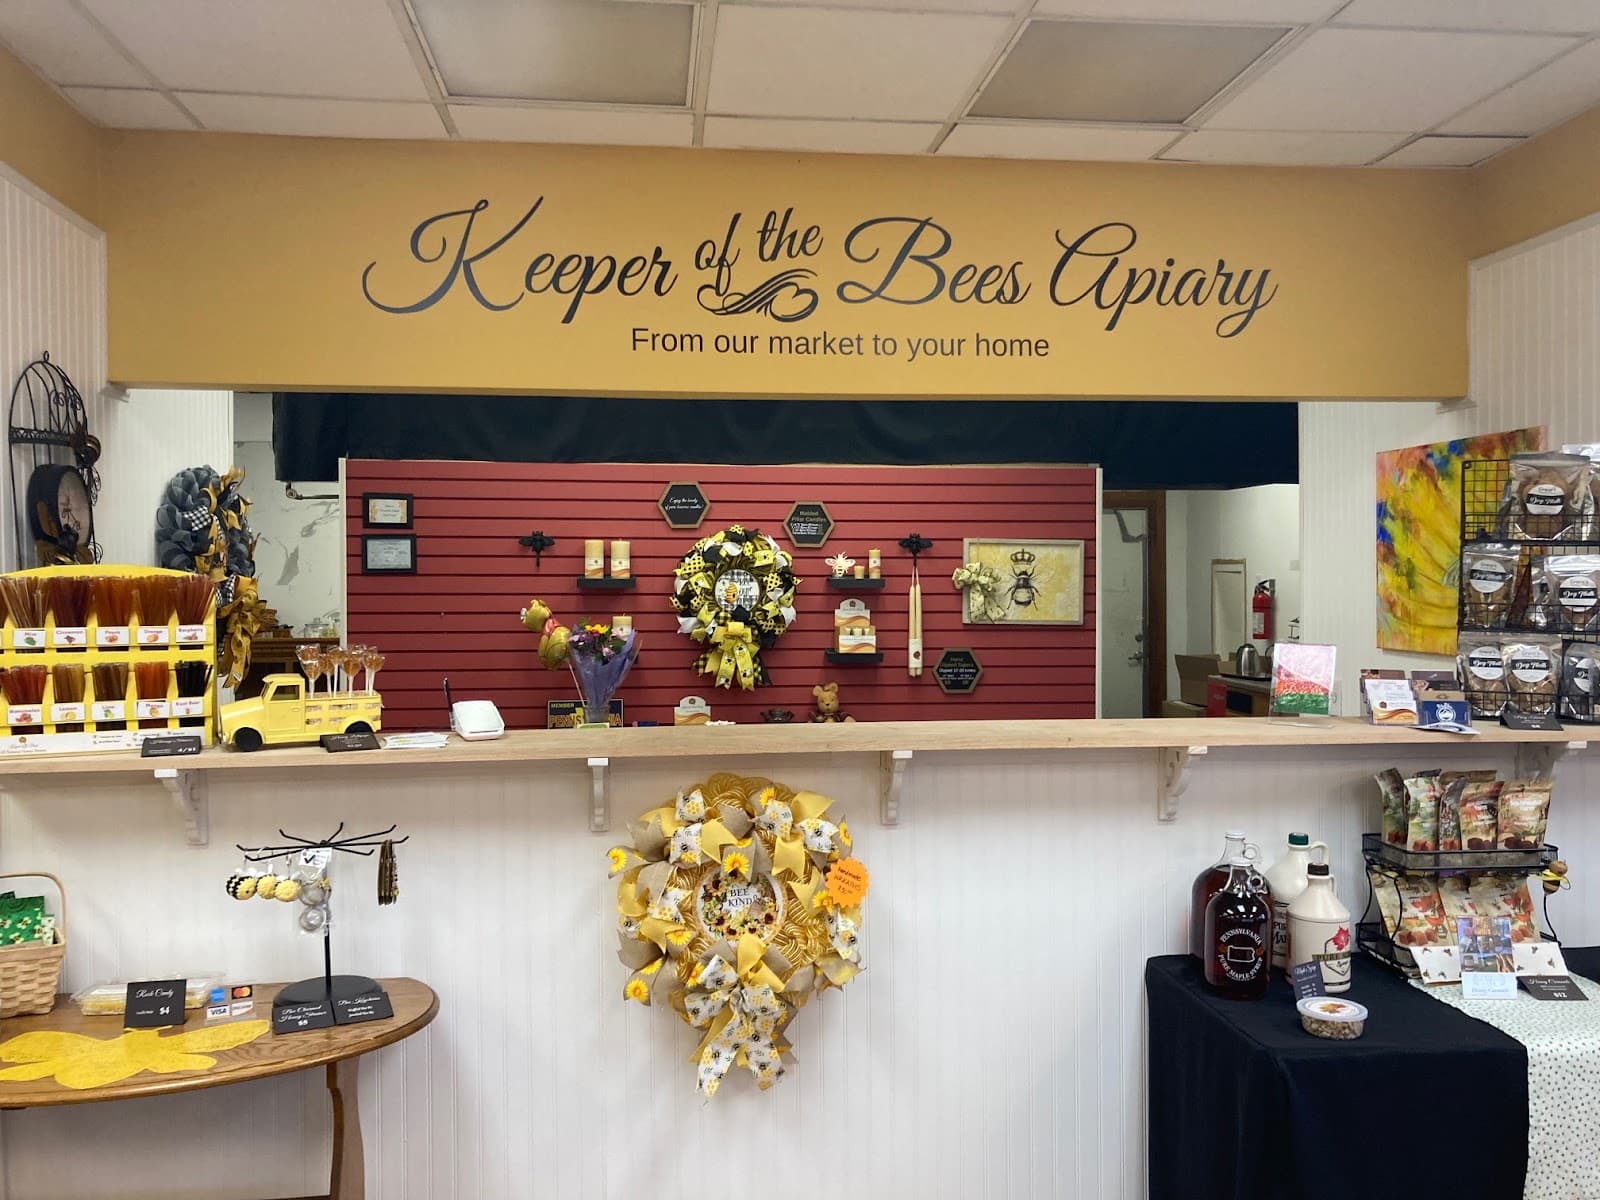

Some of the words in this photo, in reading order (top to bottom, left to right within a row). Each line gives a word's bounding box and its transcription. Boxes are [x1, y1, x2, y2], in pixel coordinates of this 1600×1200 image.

[362, 195, 678, 324] Keeper
[695, 212, 741, 297] of
[757, 207, 823, 262] the
[836, 216, 1032, 305] Bees
[1049, 222, 1279, 338] Apiary
[631, 327, 704, 353] From
[714, 332, 759, 354] our
[768, 330, 864, 356] market
[873, 332, 898, 357] to
[906, 336, 966, 362] your
[975, 333, 1050, 358] home
[728, 897, 753, 907] KIND
[730, 888, 750, 897] BEE
[1219, 928, 1263, 946] PENNSYLVANIA
[1218, 954, 1231, 971] PURE
[1228, 969, 1251, 980] MAPLE
[1249, 956, 1263, 977] SYRUP
